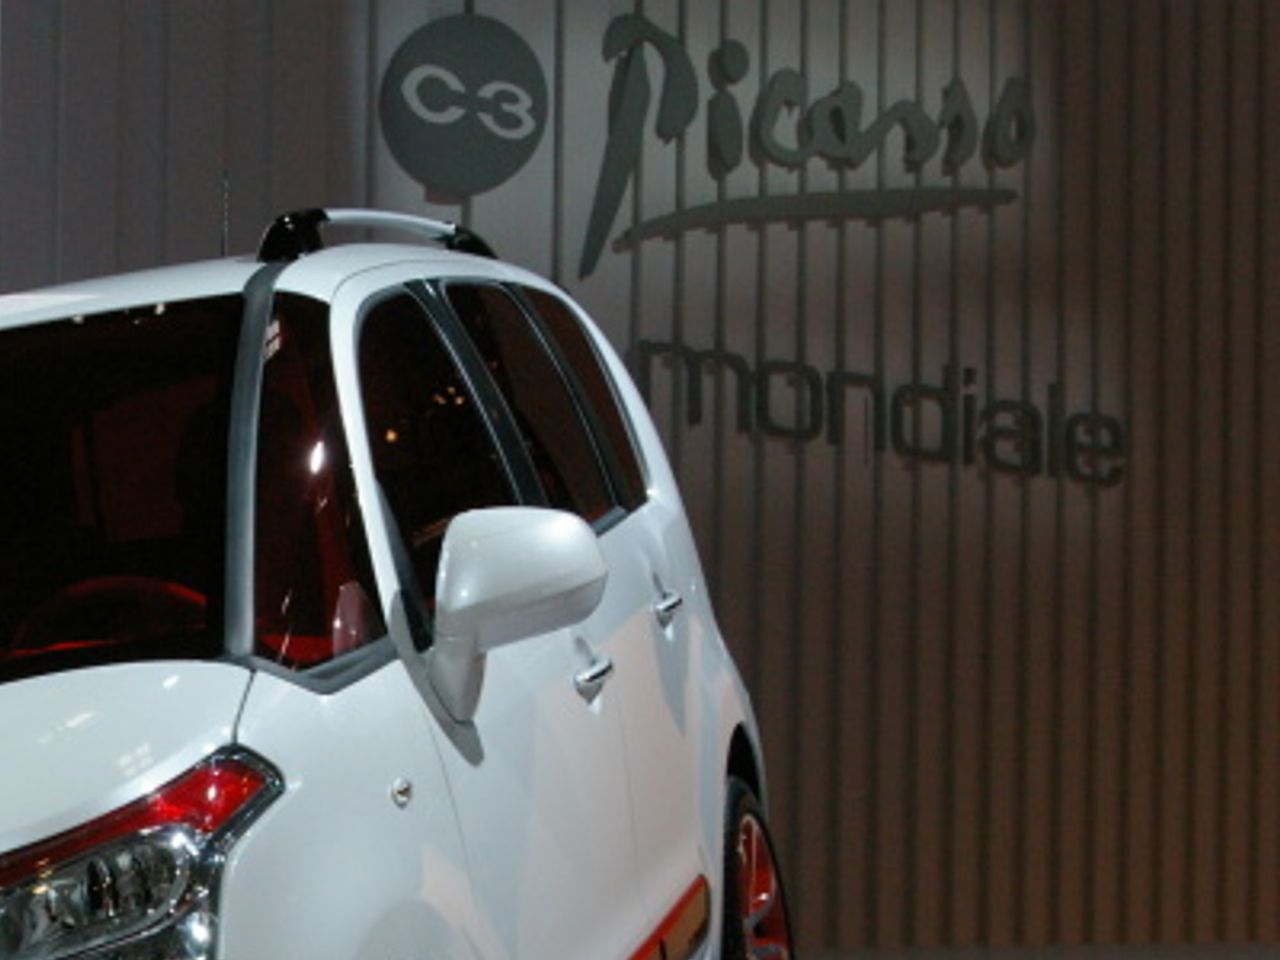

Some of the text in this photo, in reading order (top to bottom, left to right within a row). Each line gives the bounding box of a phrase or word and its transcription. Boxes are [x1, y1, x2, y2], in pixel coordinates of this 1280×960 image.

[400, 12, 1037, 280] C3 Picasso
[639, 341, 1123, 486] mondiale
